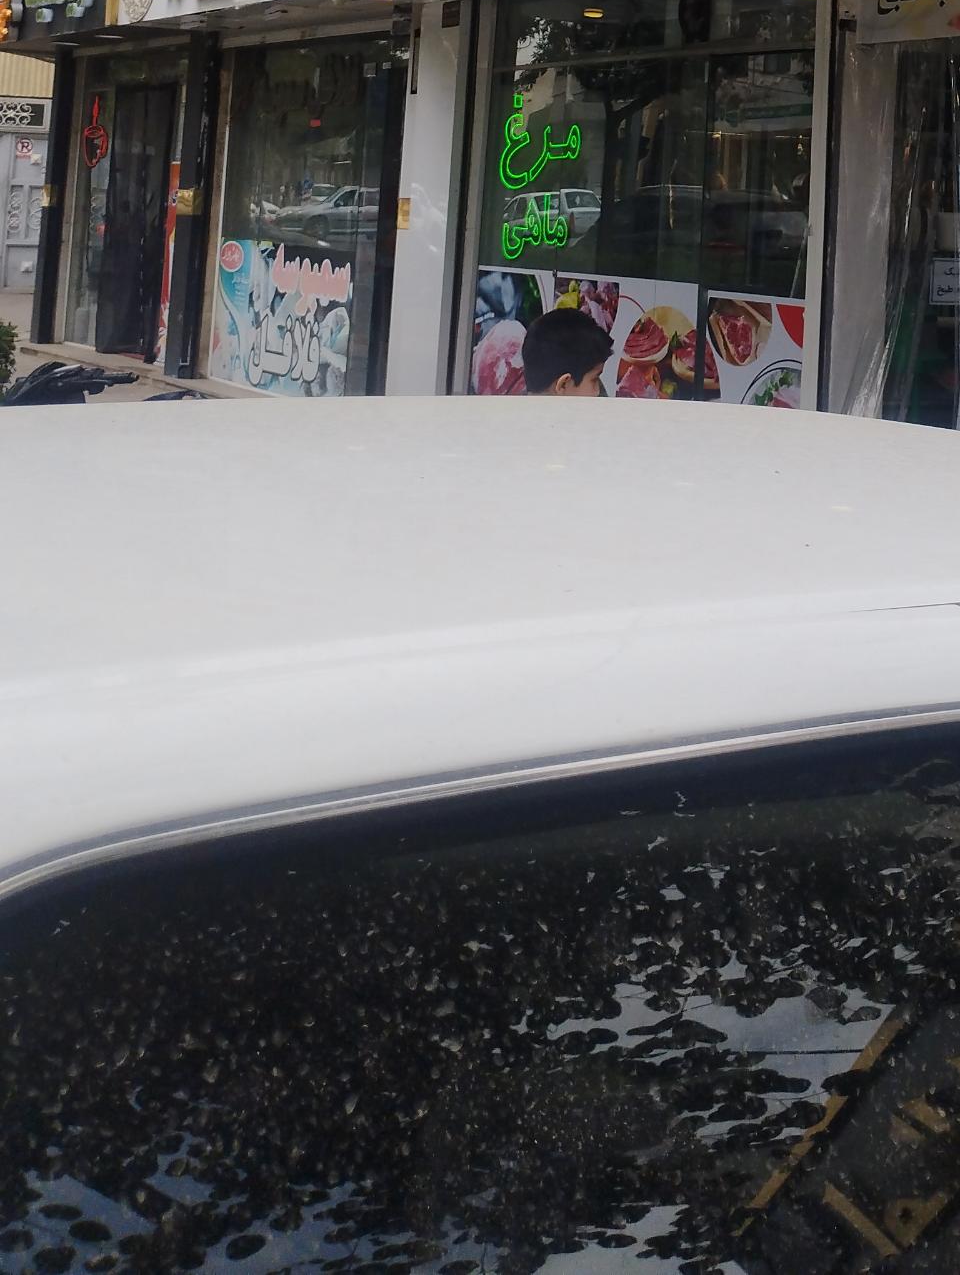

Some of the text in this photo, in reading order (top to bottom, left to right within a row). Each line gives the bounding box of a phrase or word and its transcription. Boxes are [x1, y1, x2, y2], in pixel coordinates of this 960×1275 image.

[499, 92, 583, 190] مرغ
[502, 193, 570, 260] ماهی
[248, 313, 322, 387] فلافل
